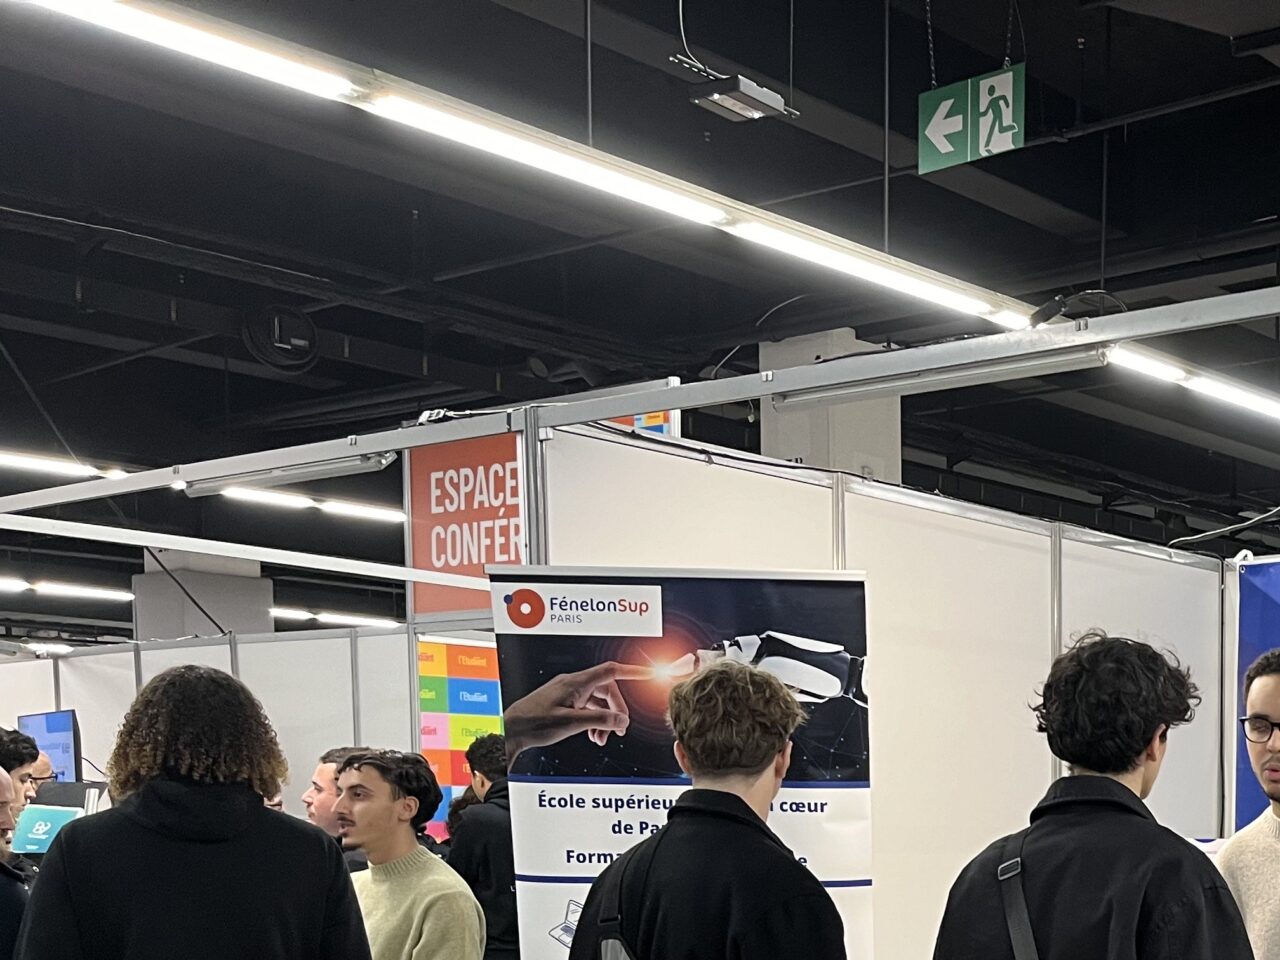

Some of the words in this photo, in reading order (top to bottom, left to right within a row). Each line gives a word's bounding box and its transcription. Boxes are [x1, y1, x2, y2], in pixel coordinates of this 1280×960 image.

[430, 461, 520, 514] ESPACE
[431, 508, 524, 568] CONFÉR
[550, 597, 649, 616] FénelonSup
[550, 614, 583, 624] PARIS
[538, 790, 586, 809] École
[592, 794, 675, 813] supérieu
[779, 800, 828, 813] cœur
[611, 820, 634, 835] de
[639, 821, 661, 835] Pa
